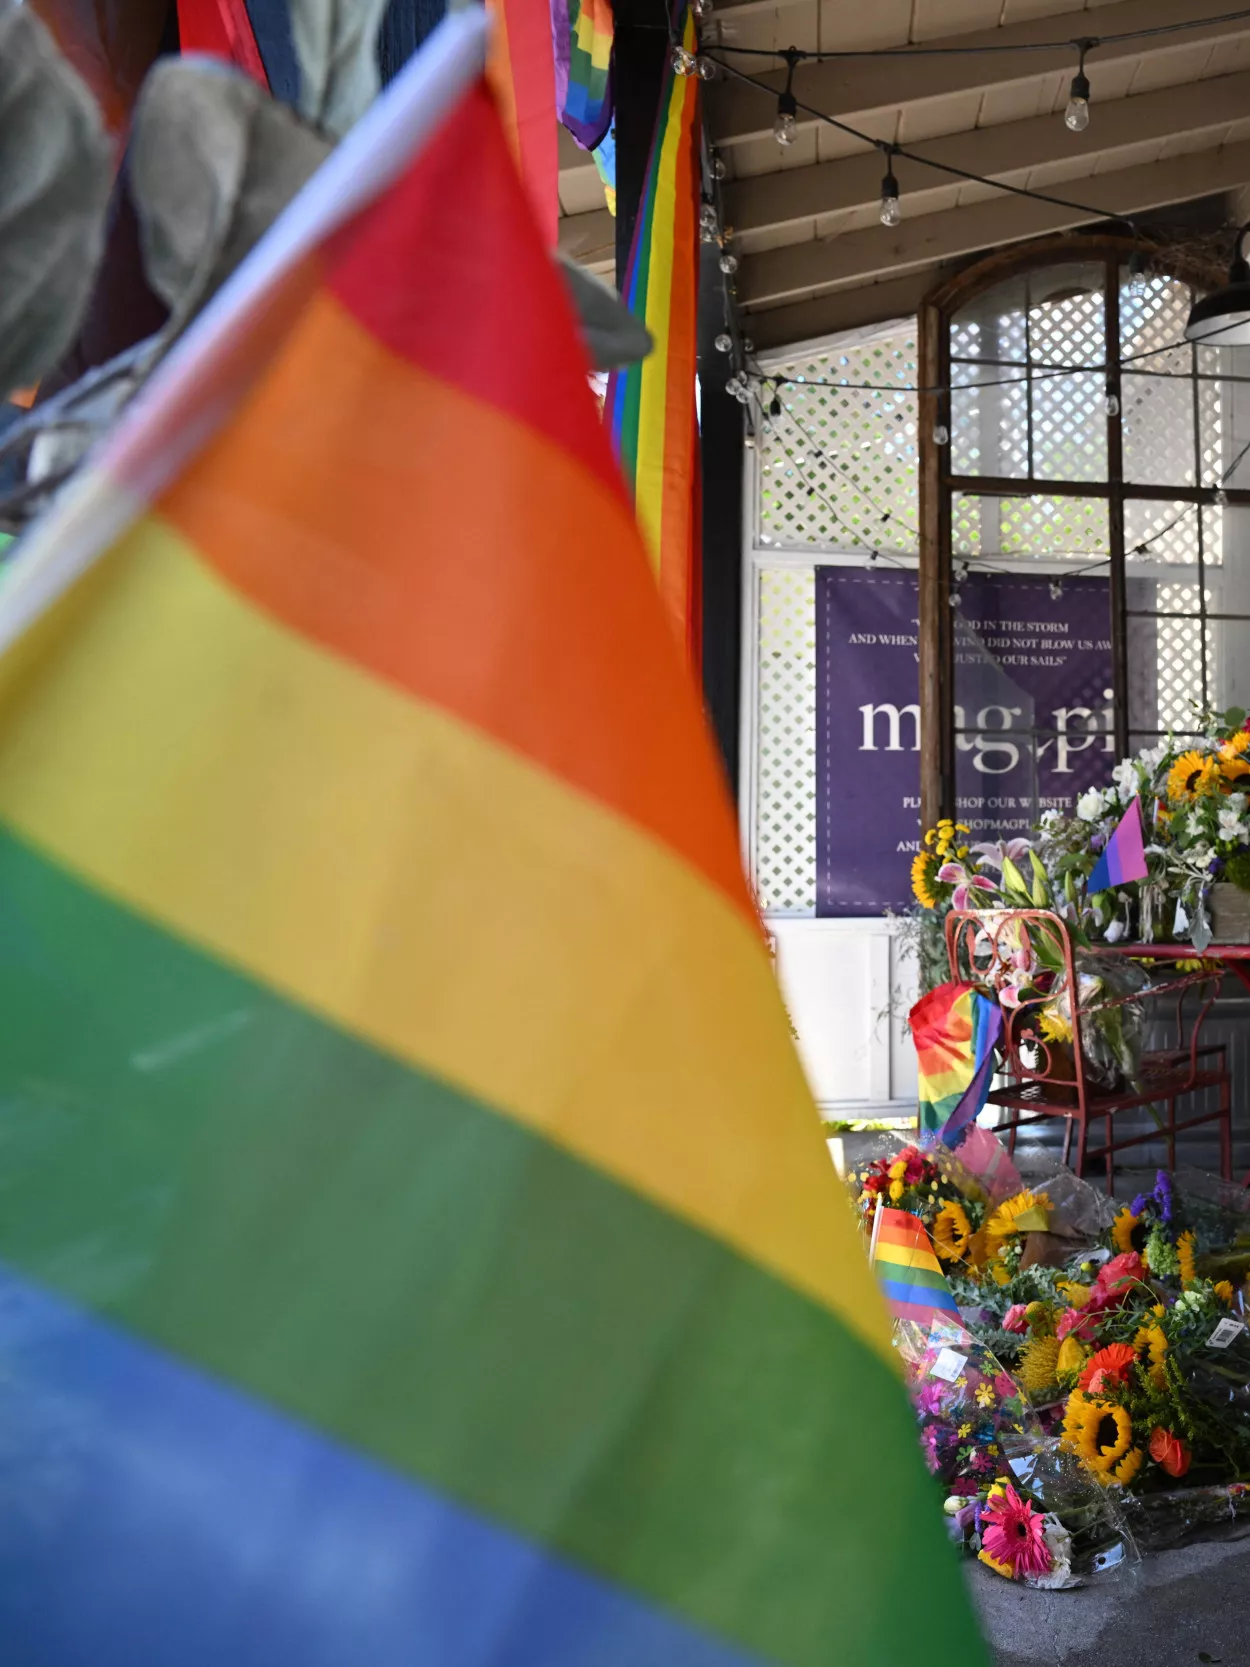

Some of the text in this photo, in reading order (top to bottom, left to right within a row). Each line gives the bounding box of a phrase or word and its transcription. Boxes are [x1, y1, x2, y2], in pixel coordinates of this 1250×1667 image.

[983, 620, 997, 630] IN
[999, 620, 1025, 632] THE
[1026, 621, 1069, 633] STORM
[848, 633, 918, 646] AND WHEN
[987, 637, 1011, 649] DID
[1012, 638, 1039, 650] NOT
[1040, 638, 1075, 650] BLOW
[1077, 640, 1094, 651] US
[1095, 640, 1113, 651] AW
[1002, 654, 1029, 666] OUR
[987, 796, 1017, 809] OUR
[1018, 796, 1073, 809] WBSITE
